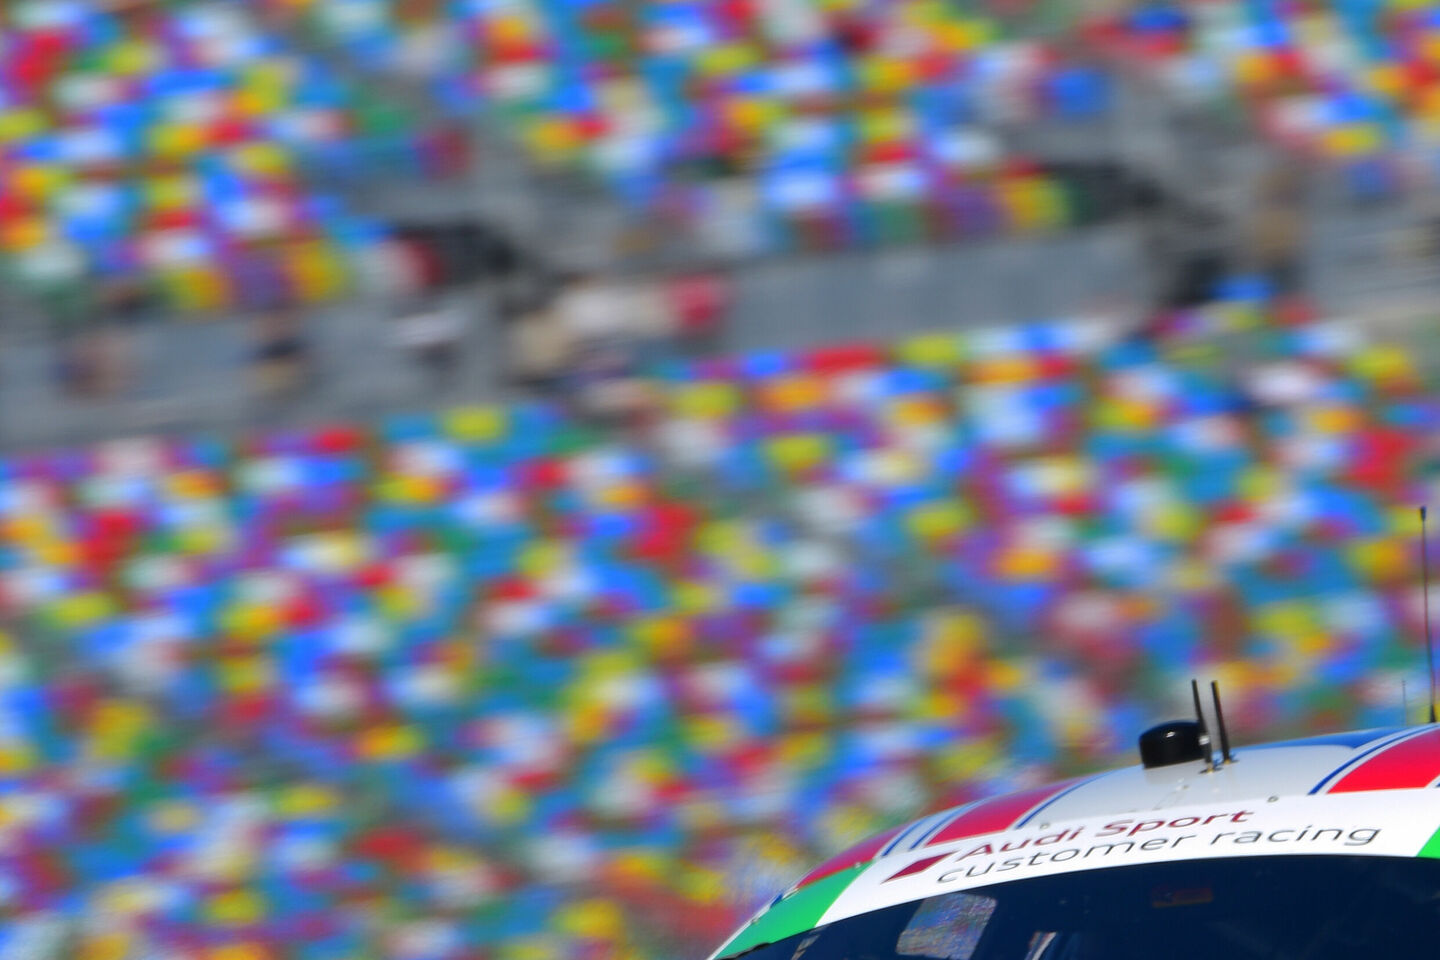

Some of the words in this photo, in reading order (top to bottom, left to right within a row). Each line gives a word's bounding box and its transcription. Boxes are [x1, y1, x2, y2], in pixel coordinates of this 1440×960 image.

[936, 833, 1197, 884] customer
[1210, 824, 1382, 847] racing
[957, 825, 1085, 862] Audi
[1095, 808, 1255, 838] Sport
